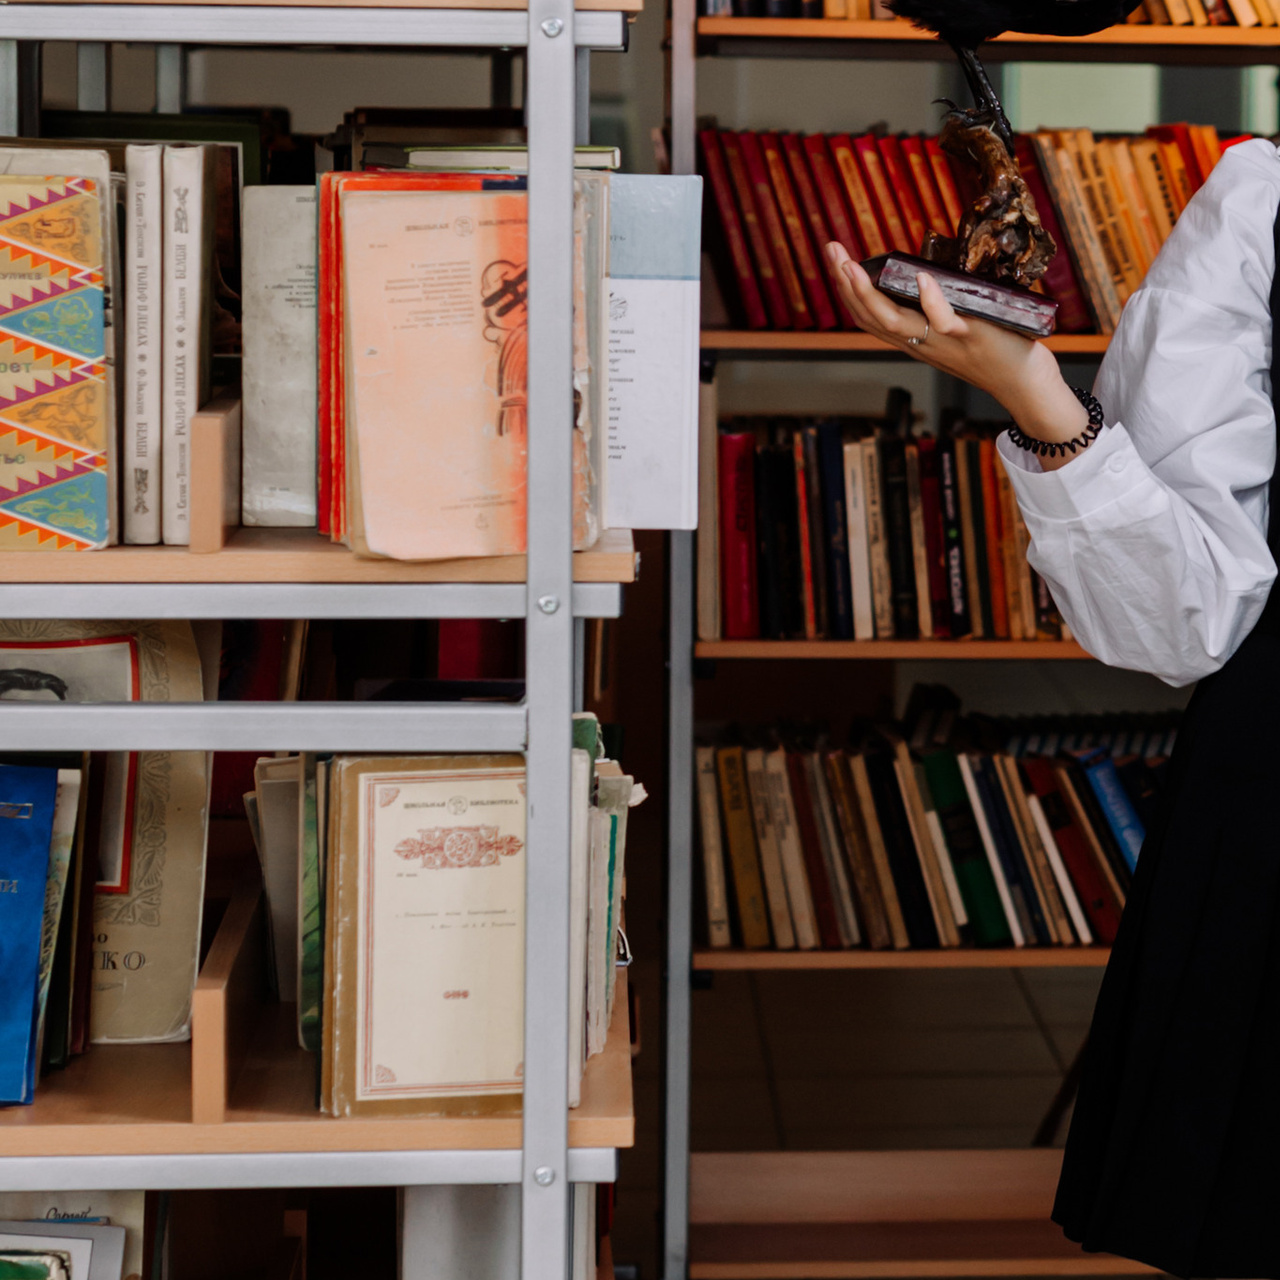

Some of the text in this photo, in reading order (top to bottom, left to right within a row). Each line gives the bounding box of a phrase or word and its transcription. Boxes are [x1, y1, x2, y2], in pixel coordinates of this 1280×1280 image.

[0, 272, 43, 281] УЛИЕВ
[174, 244, 188, 280] БЕМБИ
[136, 265, 149, 303] РОЛЬФ
[0, 362, 33, 373] оет
[174, 398, 187, 436] РОЛЬФ
[135, 421, 149, 459] БЕМБИ
